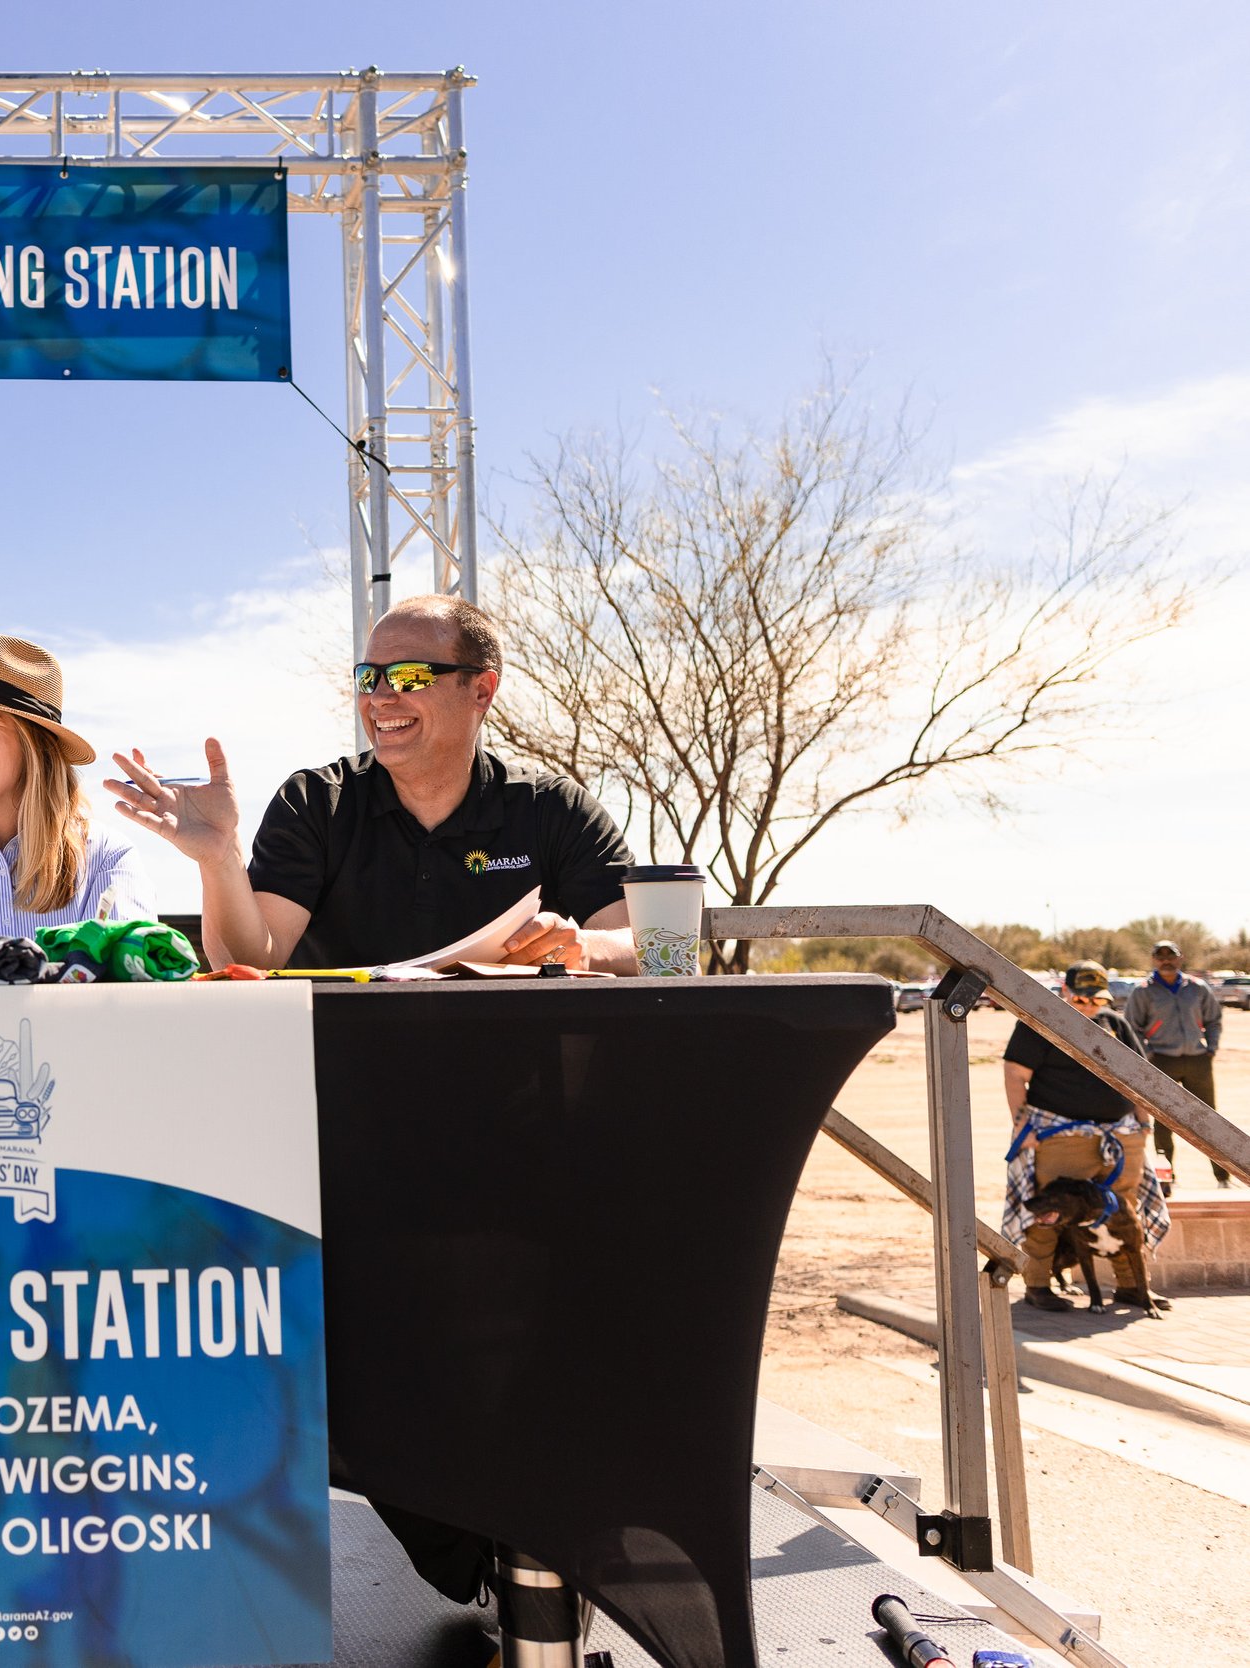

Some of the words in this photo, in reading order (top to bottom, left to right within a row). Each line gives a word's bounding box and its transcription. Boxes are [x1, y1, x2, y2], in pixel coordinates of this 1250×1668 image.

[64, 245, 239, 310] STATION
[487, 854, 530, 868] MARANA
[0, 1145, 36, 1155] MARANA
[14, 1164, 39, 1185] DAY
[9, 1266, 283, 1361] STATION
